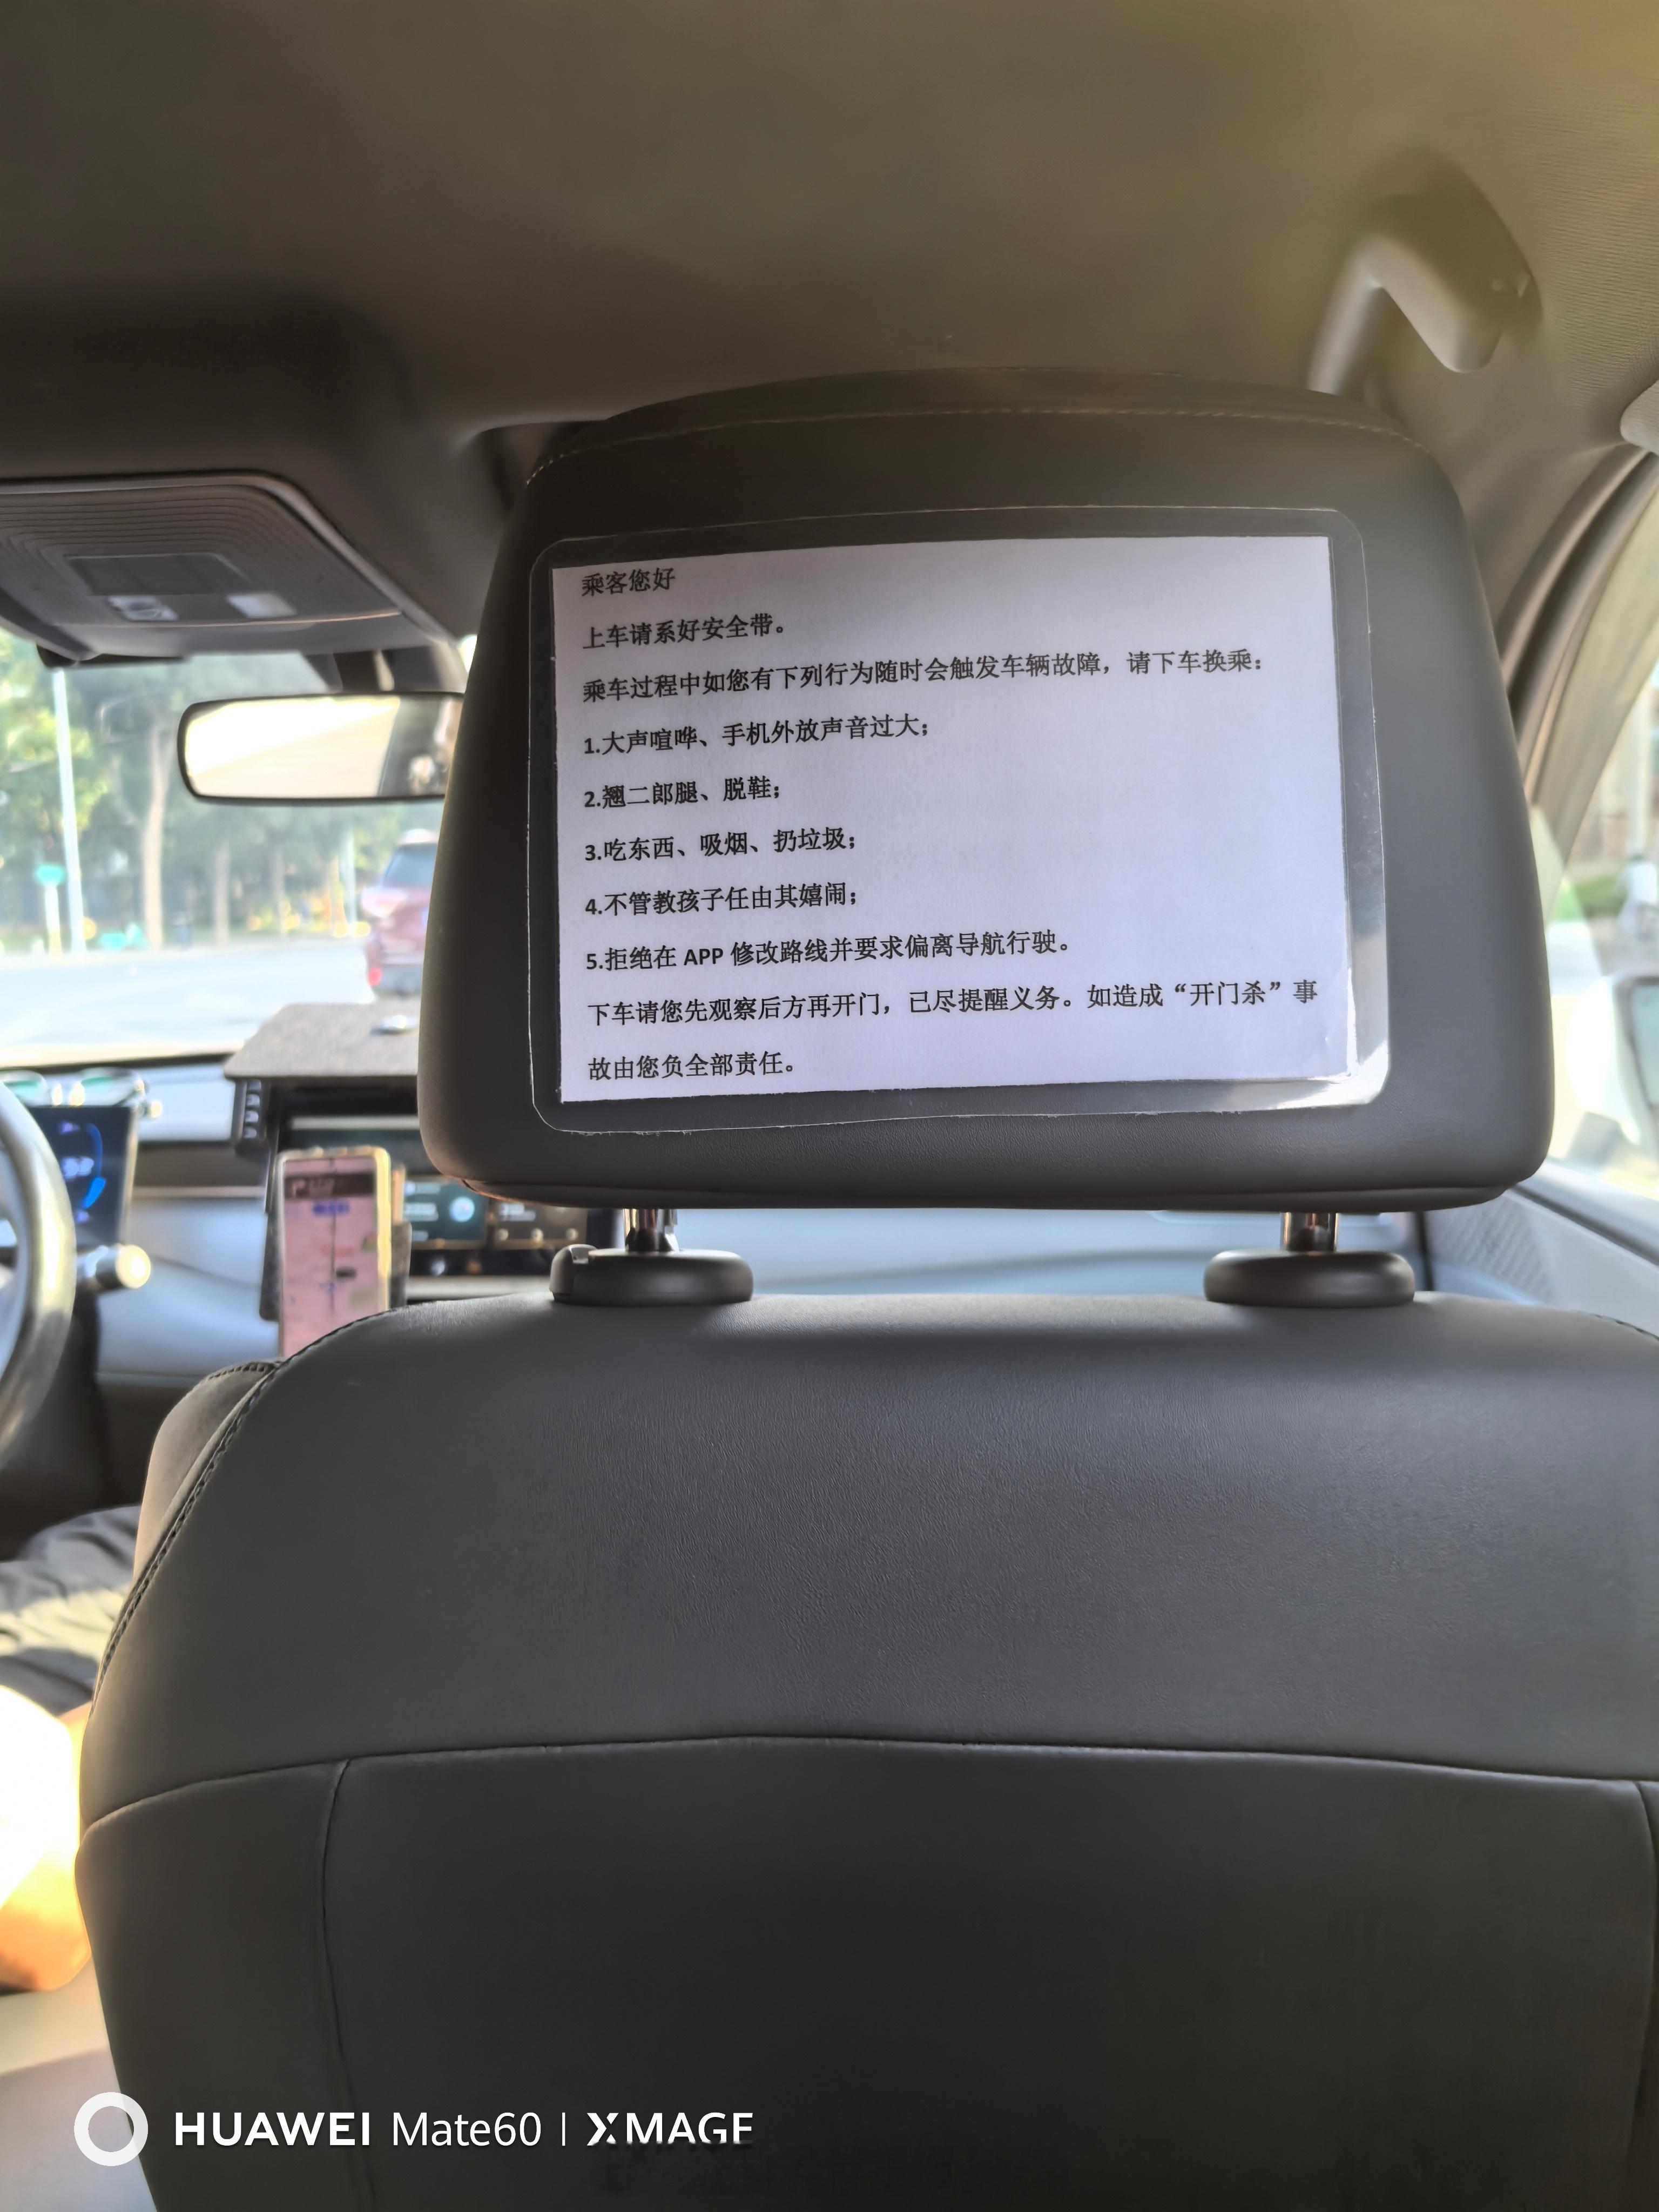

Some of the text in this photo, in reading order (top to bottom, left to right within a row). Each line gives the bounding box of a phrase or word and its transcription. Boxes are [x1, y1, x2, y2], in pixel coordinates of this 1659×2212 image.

[582, 568, 676, 597] 乘客您好
[583, 612, 784, 649] 上车请系好安全带。
[584, 775, 780, 810] 2.翘二郎腿、脱鞋；
[584, 826, 855, 861] 3.吃东西、吸烟、扔垃圾；
[584, 881, 856, 916] 4.不管教孩子任由其嬉闹；
[586, 928, 1068, 972] 5.拒绝在 APP 修改路线并要求偏离导航行驶。
[588, 1050, 793, 1081] 故由您负全部责任。
